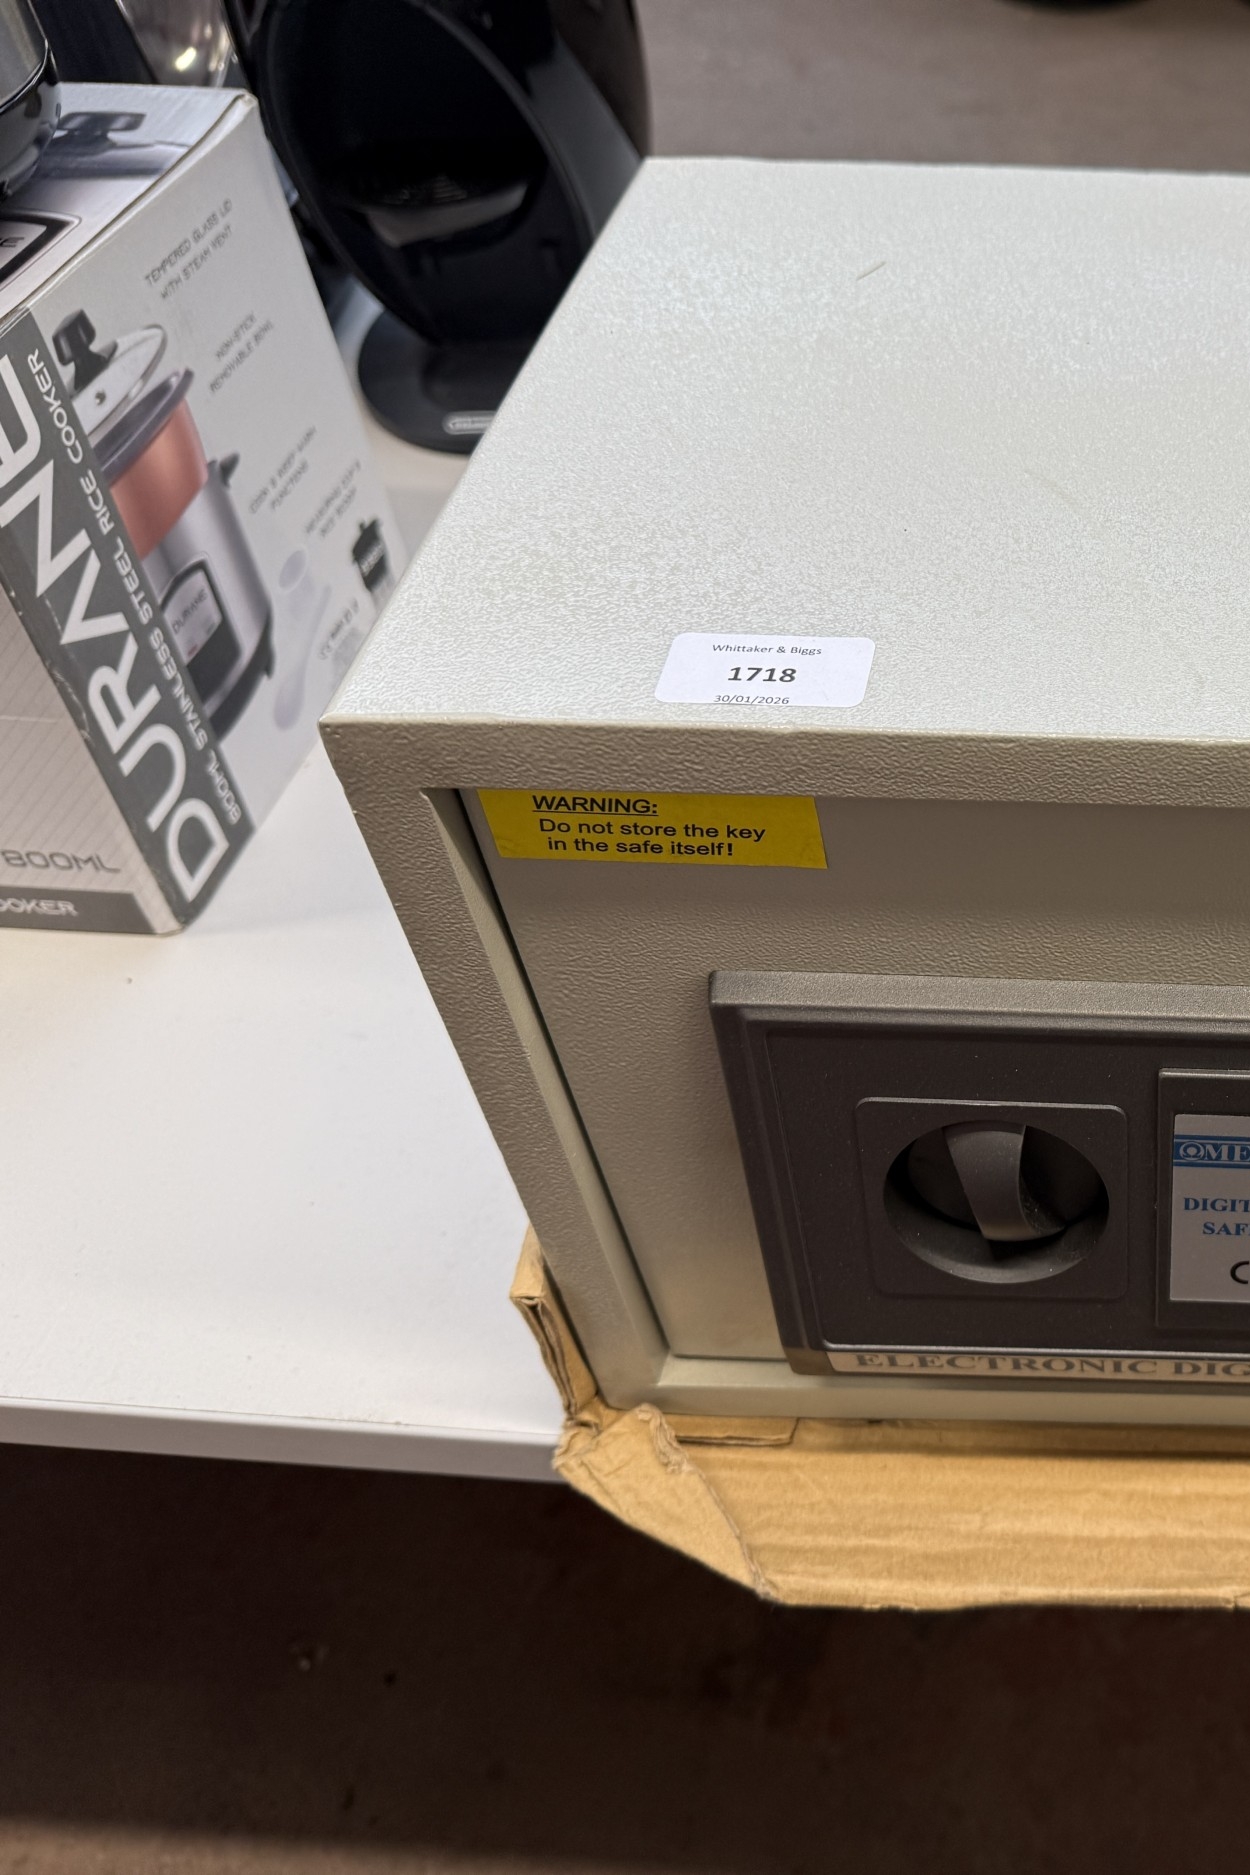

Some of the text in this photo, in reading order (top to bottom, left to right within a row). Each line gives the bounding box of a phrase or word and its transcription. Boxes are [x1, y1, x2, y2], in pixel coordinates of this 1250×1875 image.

[27, 348, 240, 825] 800ML STAINLESS STEEL RICE COOKER
[712, 644, 822, 656] Whittaker & Biggs
[727, 666, 798, 683] 1718
[713, 694, 790, 705] 30/01/2026
[532, 795, 659, 815] WARNING:
[539, 818, 766, 843] Do not store the key
[547, 837, 734, 857] in the safe itself!
[3, 849, 121, 874] 800ML
[856, 1353, 1157, 1374] ELECTRONIC
